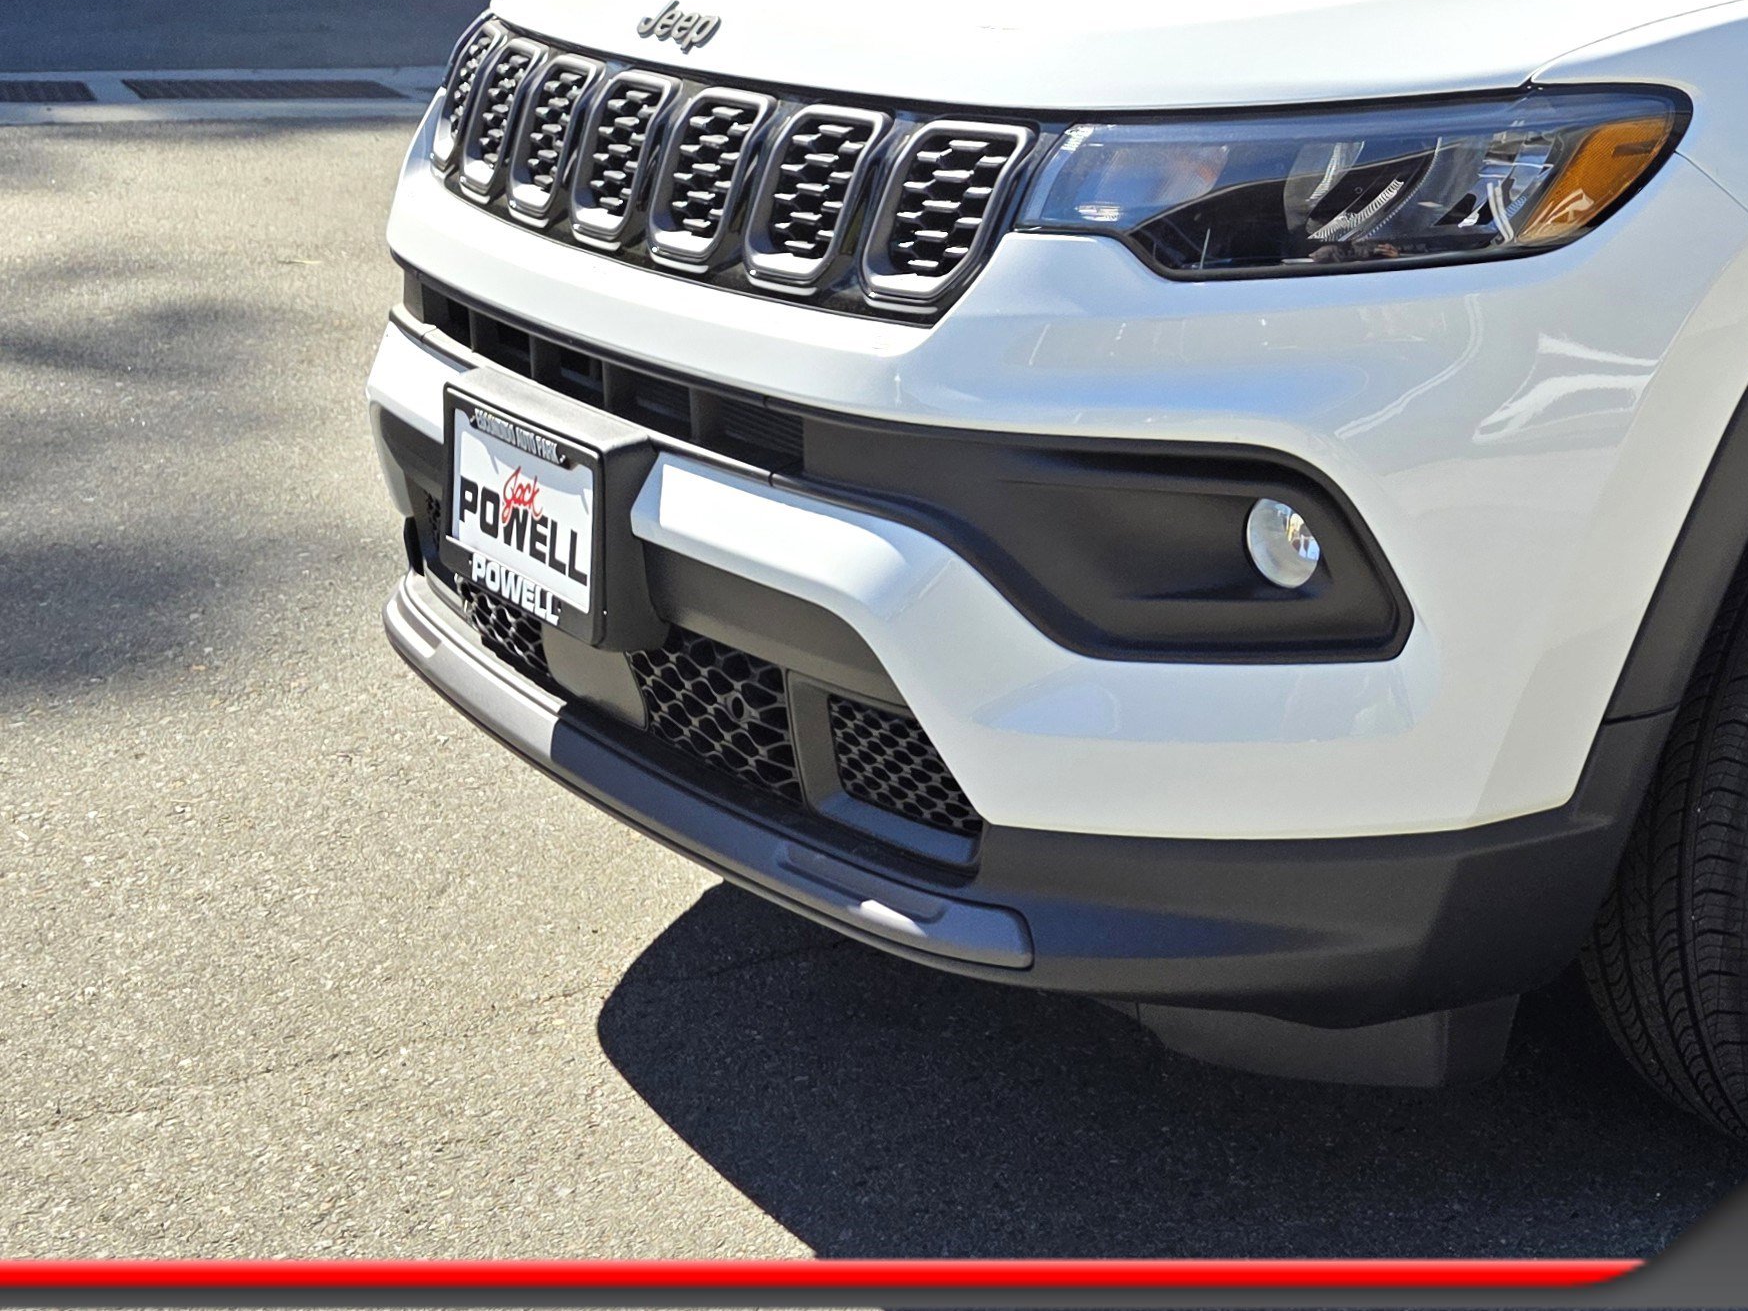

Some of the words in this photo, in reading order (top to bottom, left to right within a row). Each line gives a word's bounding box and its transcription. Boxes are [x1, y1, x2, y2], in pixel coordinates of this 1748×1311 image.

[637, 0, 721, 55] Jeep
[502, 466, 543, 527] Jack
[459, 476, 588, 586] POWELL
[471, 553, 560, 627] POWELL
